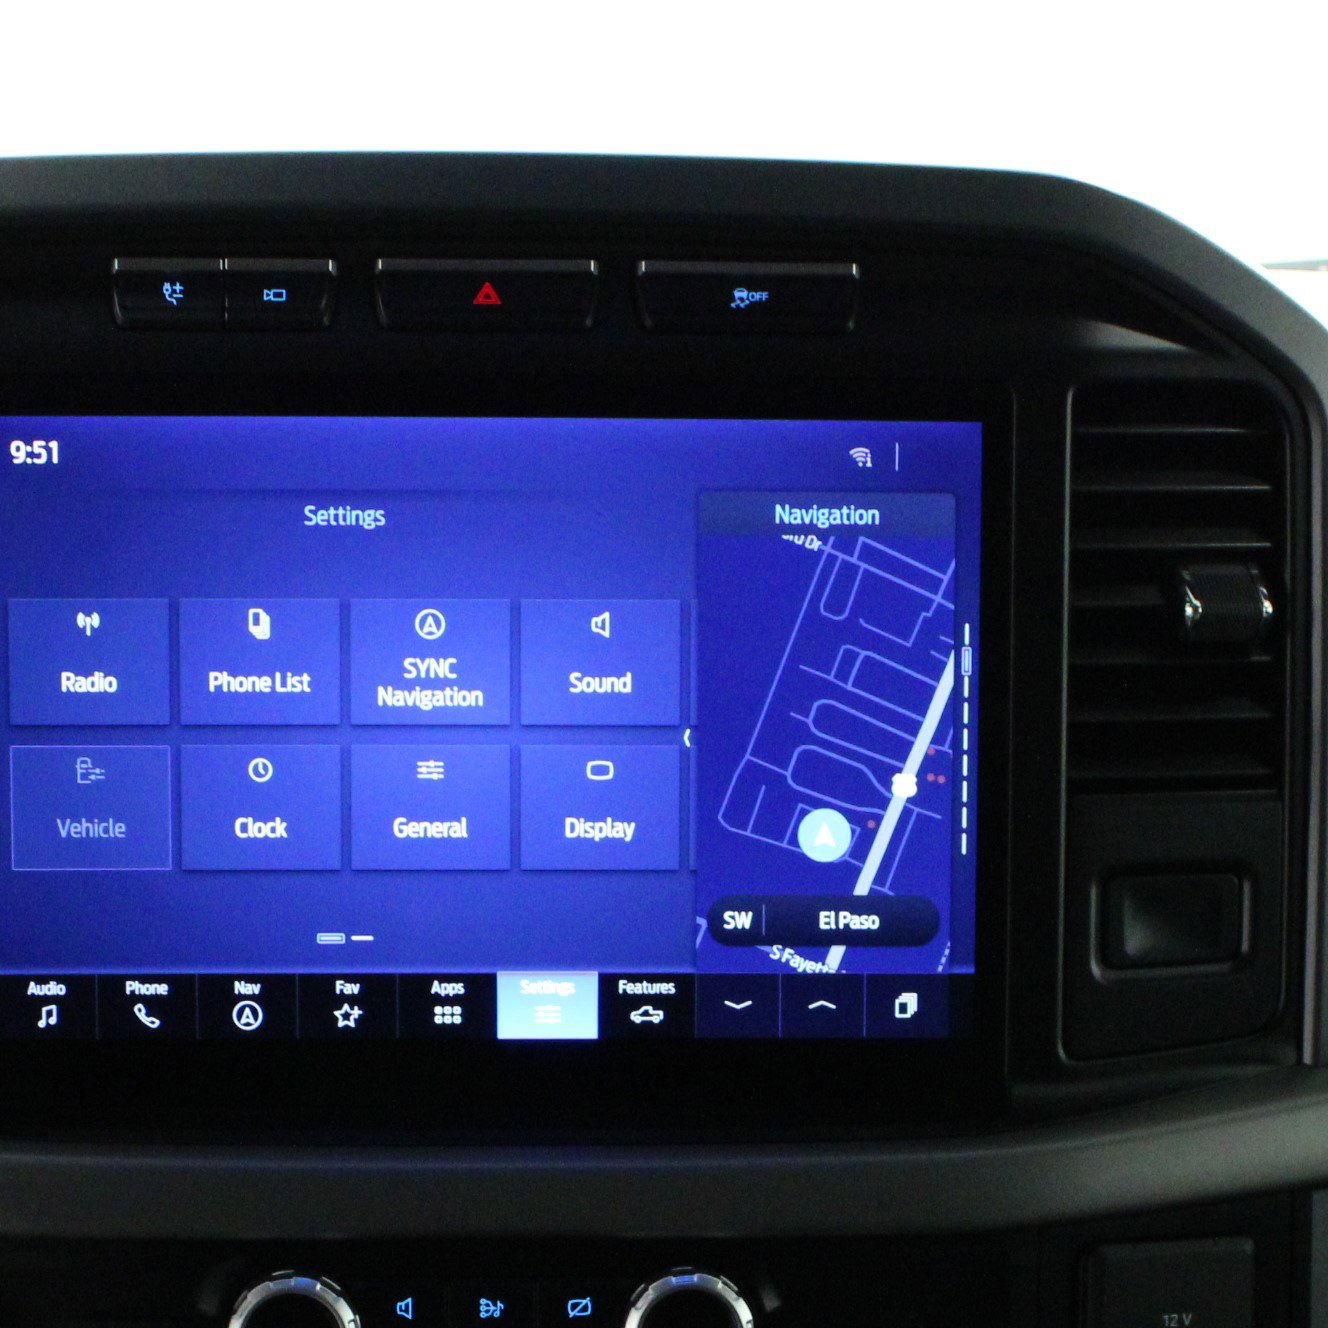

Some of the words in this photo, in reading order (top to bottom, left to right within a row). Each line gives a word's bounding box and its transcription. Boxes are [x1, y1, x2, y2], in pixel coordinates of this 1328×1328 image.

[748, 291, 769, 302] OFF
[10, 440, 58, 464] 9:51
[304, 505, 385, 529] Settings
[775, 504, 879, 528] Navigation
[404, 658, 457, 678] SYNC
[61, 672, 117, 692] Radio
[209, 671, 272, 692] Phone
[275, 672, 310, 692] List
[570, 672, 631, 693] Sound
[378, 686, 483, 710] Navigation
[57, 818, 126, 837] Vehicle
[235, 817, 287, 838] Clock
[393, 817, 467, 838] General
[565, 817, 635, 841] Display
[724, 911, 752, 929] SW
[819, 911, 836, 929] El
[839, 911, 879, 929] Paso
[769, 944, 783, 960] S
[27, 981, 66, 995] Audio
[126, 981, 168, 995] Phone
[234, 981, 261, 994] Nav
[336, 980, 360, 994] Fav
[431, 980, 465, 996] Apps
[519, 979, 576, 996] Settings
[619, 980, 675, 994] Features
